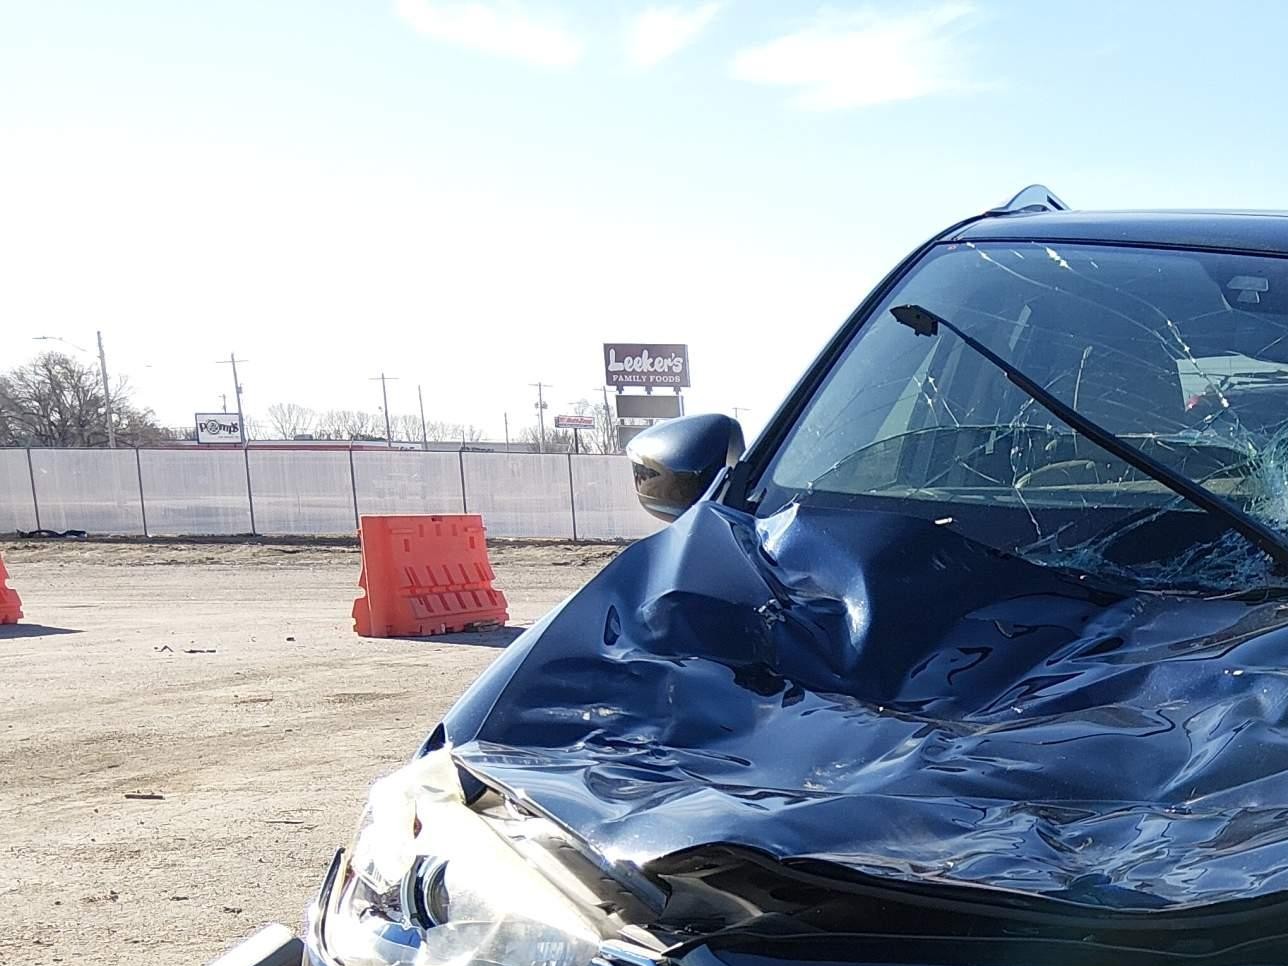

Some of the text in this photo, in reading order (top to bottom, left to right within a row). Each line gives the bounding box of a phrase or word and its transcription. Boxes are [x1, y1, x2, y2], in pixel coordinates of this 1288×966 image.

[607, 348, 684, 373] Leeker's
[612, 374, 681, 383] FAMILY FOODS
